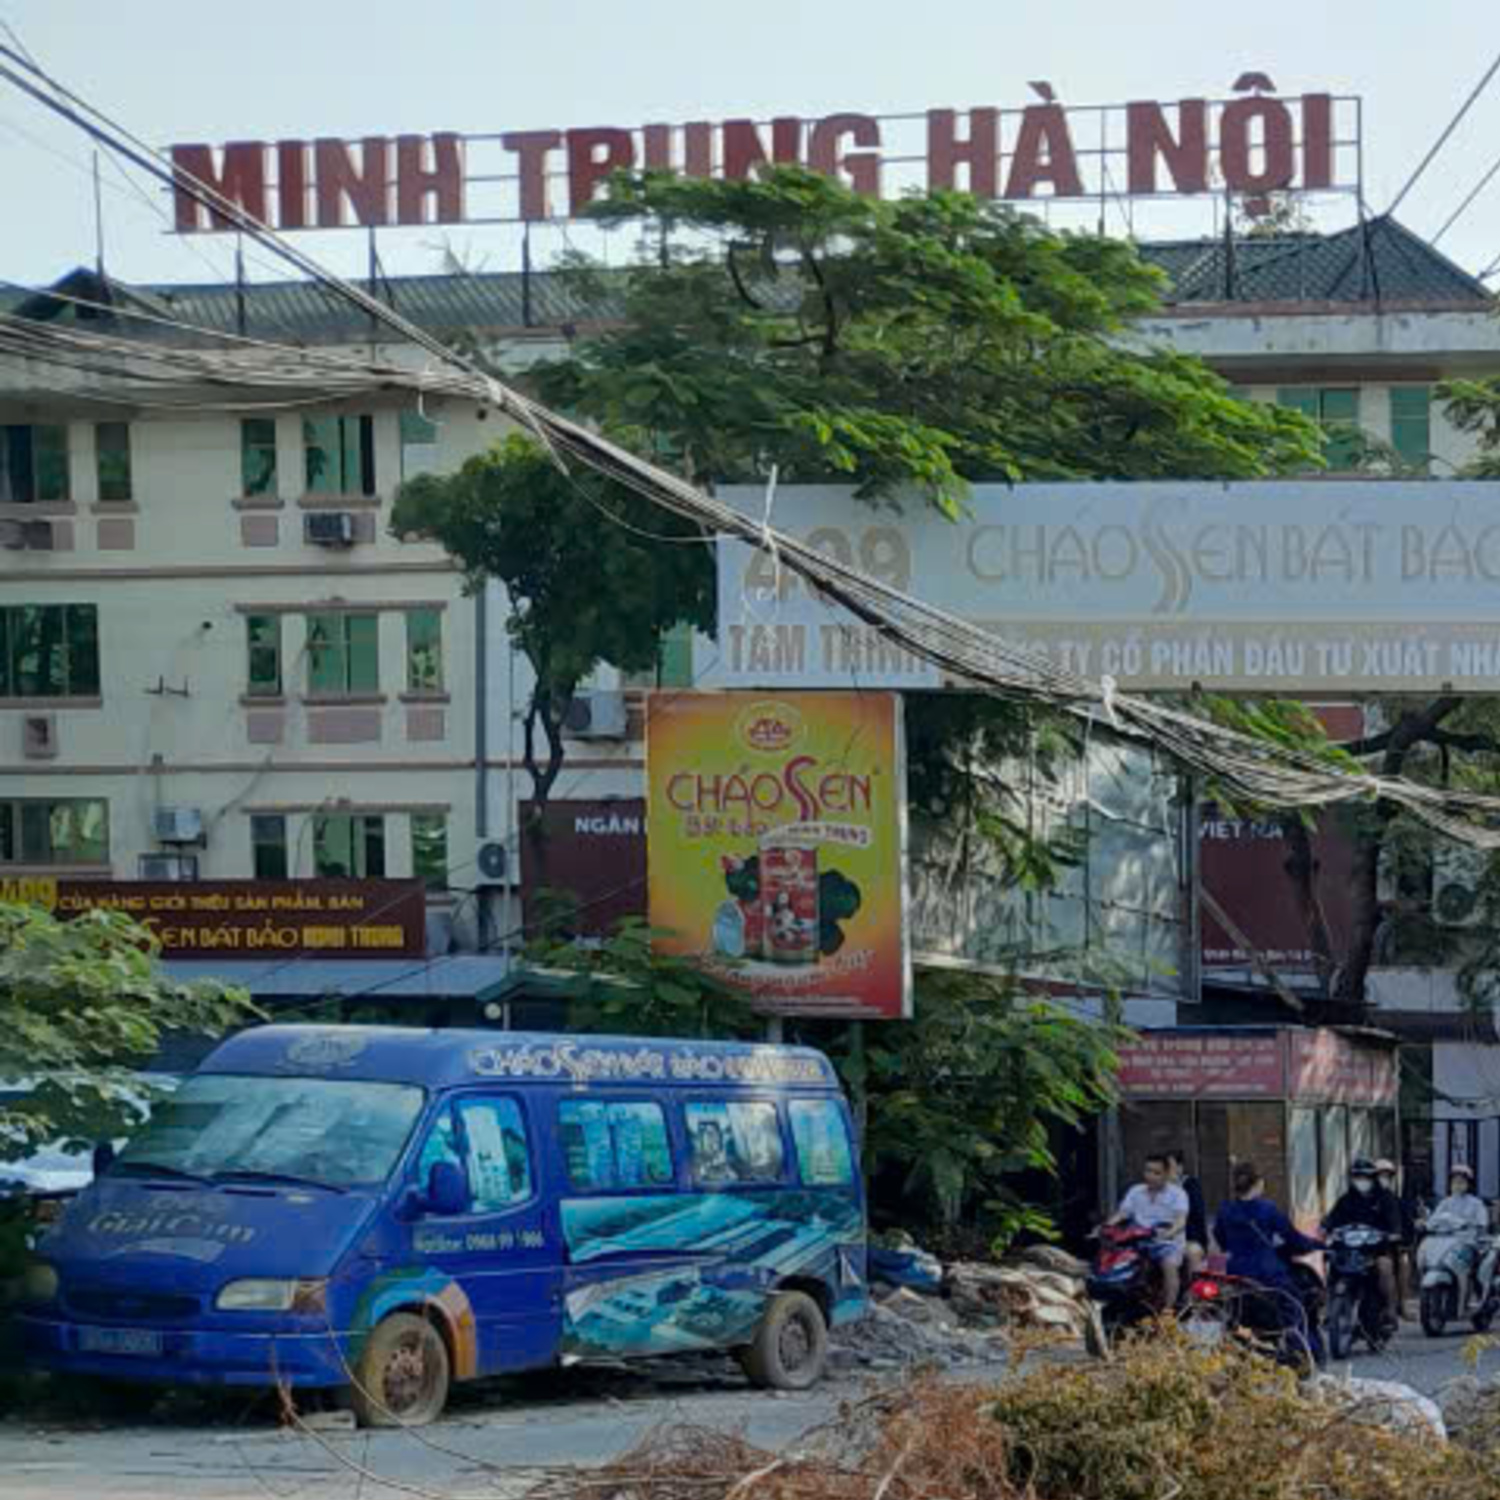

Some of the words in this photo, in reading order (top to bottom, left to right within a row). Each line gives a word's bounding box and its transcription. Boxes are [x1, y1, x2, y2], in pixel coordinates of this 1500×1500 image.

[171, 132, 465, 233] MINH
[501, 113, 883, 222] TRUNG
[926, 80, 1086, 199] HÀ
[1125, 71, 1336, 217] NỘI
[966, 502, 1137, 582] CHÁO
[1282, 505, 1383, 583] BÁT
[1058, 639, 1094, 677] TY
[666, 763, 783, 812] CHÁO
[574, 813, 640, 834] NGÂN
